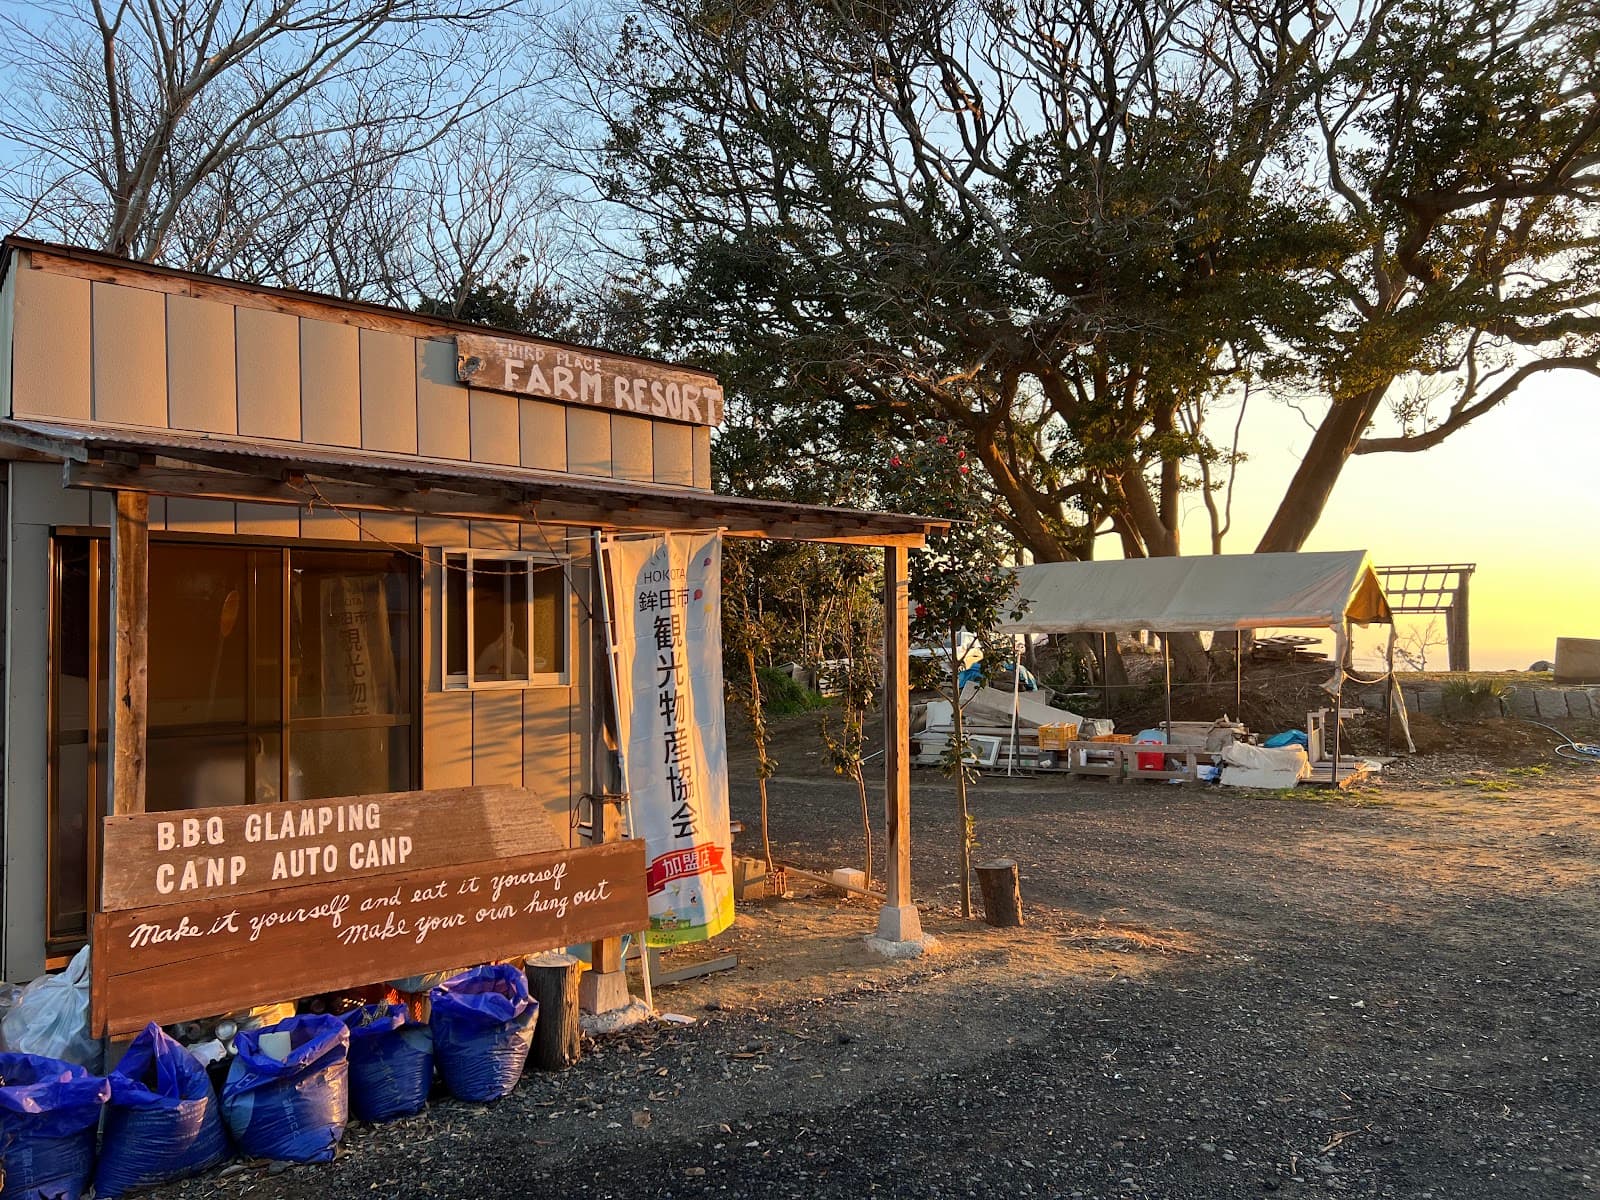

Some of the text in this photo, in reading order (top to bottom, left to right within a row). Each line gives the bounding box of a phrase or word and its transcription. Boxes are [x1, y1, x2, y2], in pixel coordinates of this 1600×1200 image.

[496, 342, 603, 373] THIRD PLACE
[504, 358, 721, 426] FARM RESORT
[638, 588, 690, 612] 鉾田市
[644, 568, 685, 584] HOKOTA
[653, 613, 700, 839] 観光物産協会
[157, 803, 381, 851] B.B.Q GLAMPING
[156, 836, 413, 895] CANP AUTO CANP
[662, 846, 711, 878] 加盟店
[128, 862, 568, 949] Make it yourself and eat it yourself
[415, 915, 467, 944] your
[524, 890, 569, 918] hang
[574, 879, 612, 905] out
